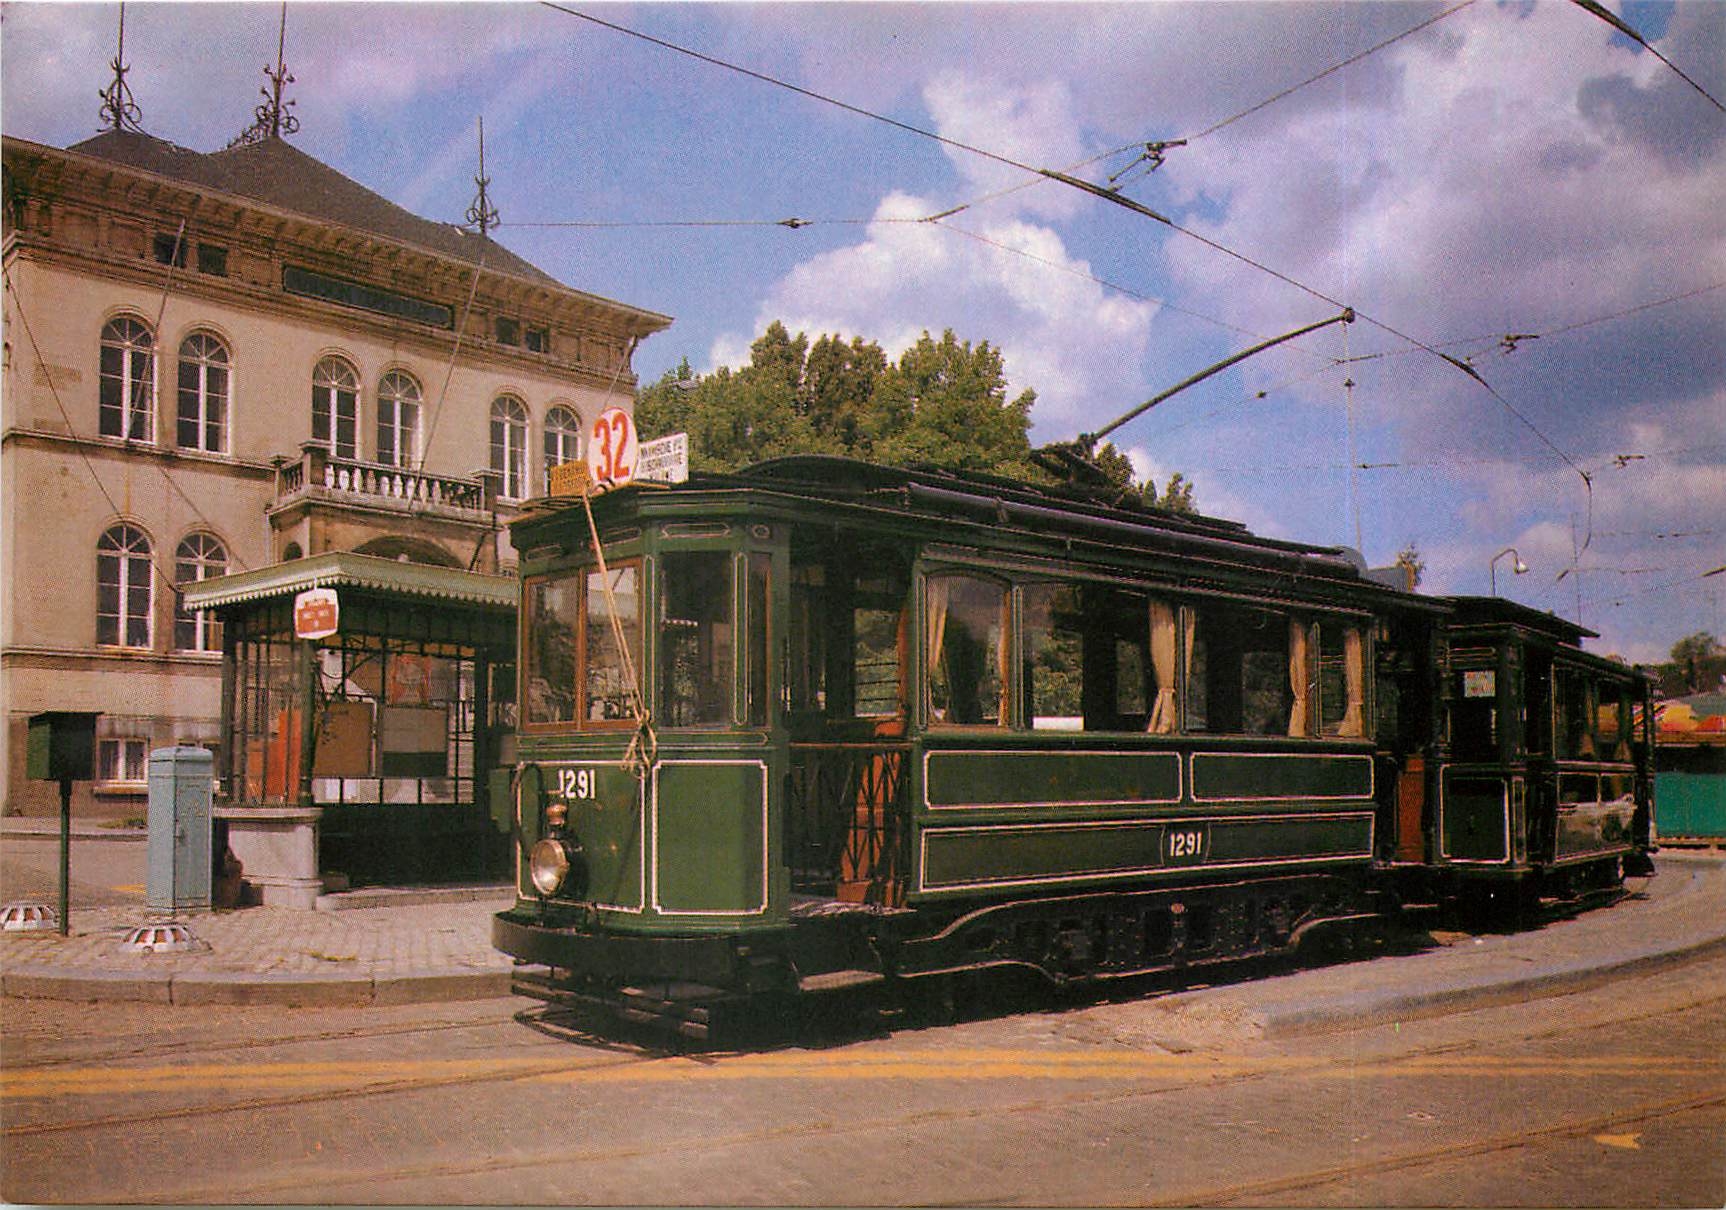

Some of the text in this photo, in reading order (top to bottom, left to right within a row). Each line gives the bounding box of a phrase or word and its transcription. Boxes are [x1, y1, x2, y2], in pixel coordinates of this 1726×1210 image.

[594, 411, 629, 480] 32
[557, 769, 595, 799] 1291
[1169, 831, 1202, 857] 1291
